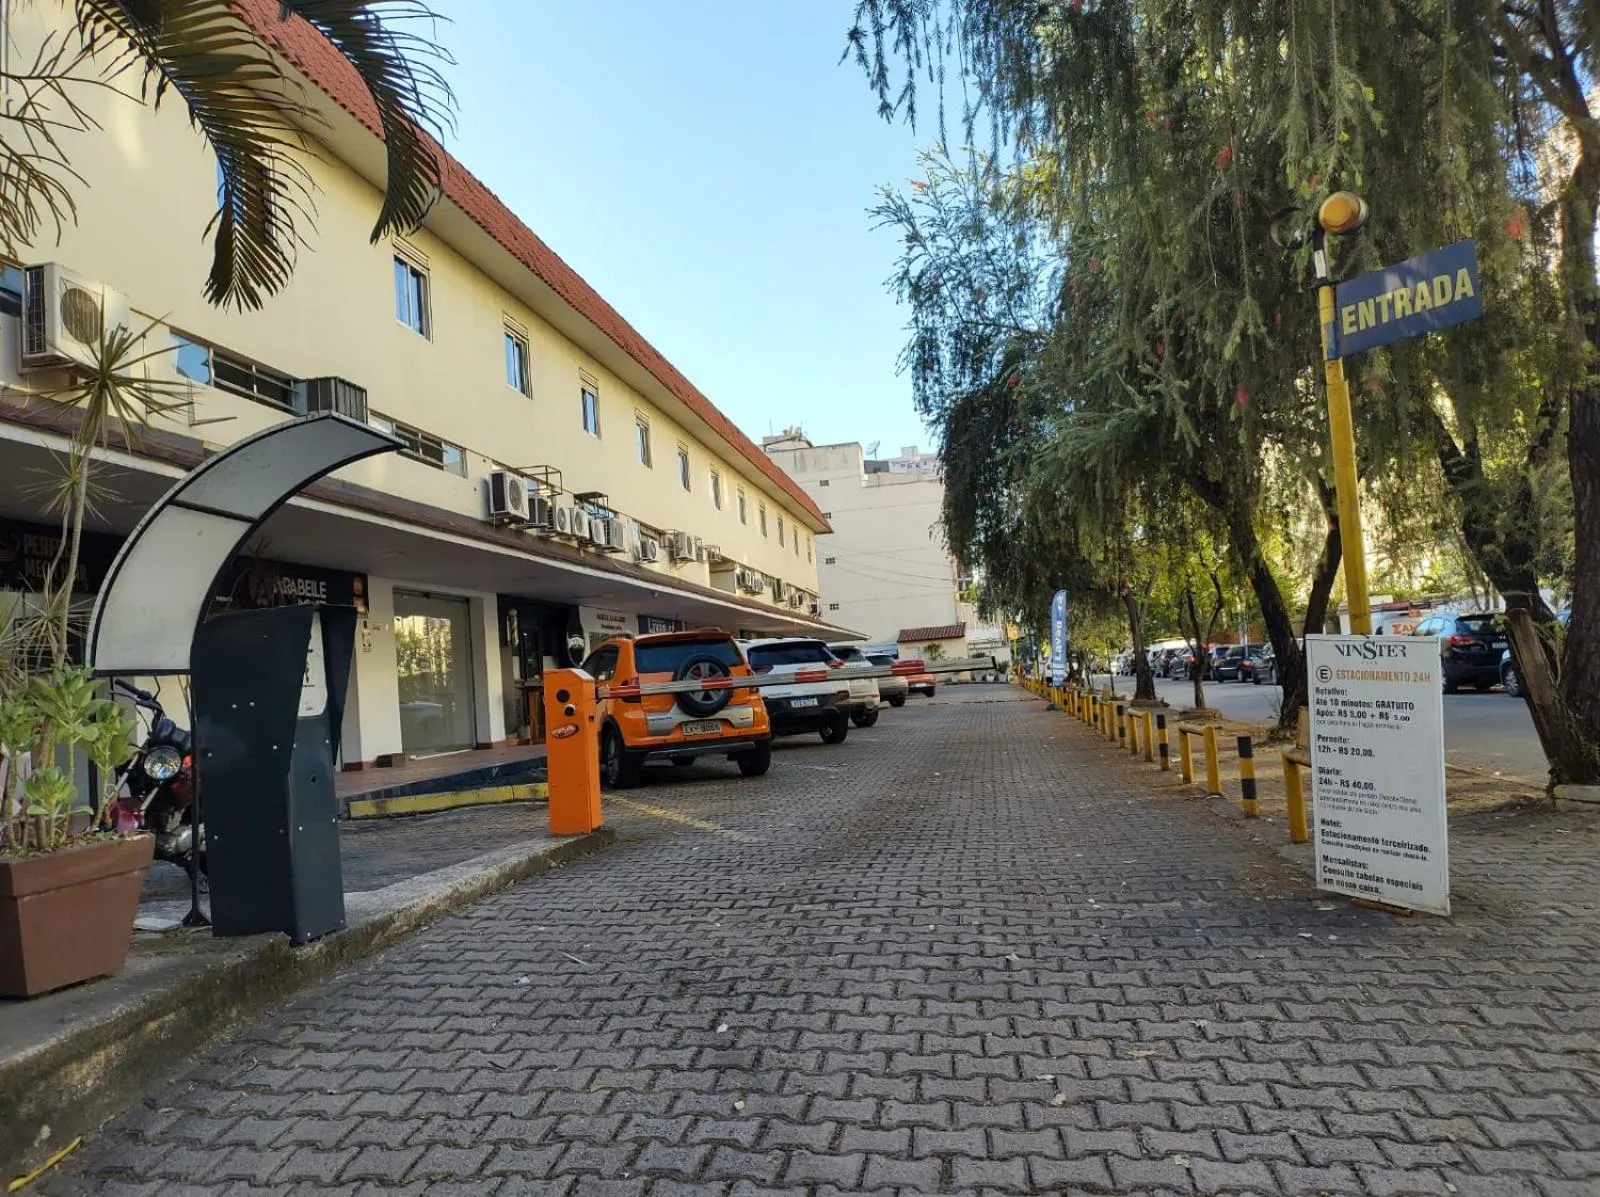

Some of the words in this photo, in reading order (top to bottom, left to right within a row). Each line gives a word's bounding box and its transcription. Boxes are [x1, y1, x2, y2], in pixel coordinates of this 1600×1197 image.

[1341, 267, 1475, 335] ENTRADA
[1336, 669, 1410, 682] ESTACIONAMENTO
[1413, 671, 1431, 683] 24H
[1315, 687, 1348, 696] Rotativo:
[1341, 700, 1373, 708] minutos:
[1375, 700, 1415, 710] GRATUITO
[1316, 708, 1335, 718] Após:
[1338, 709, 1348, 718] R$
[1379, 711, 1389, 721] R$
[1317, 745, 1331, 753] 12h
[1339, 747, 1348, 755] R$
[1319, 777, 1332, 786] 24h
[1340, 780, 1350, 788] R$
[1320, 818, 1342, 828] Hotel:
[1321, 829, 1379, 845] Estacionamento
[1381, 838, 1431, 853] terceirizado.
[1322, 854, 1368, 869] Mensalistas:
[1323, 865, 1354, 877] Consulte
[1356, 871, 1384, 883] tabelas
[1386, 878, 1423, 891] especiais
[1336, 880, 1357, 889] nosso
